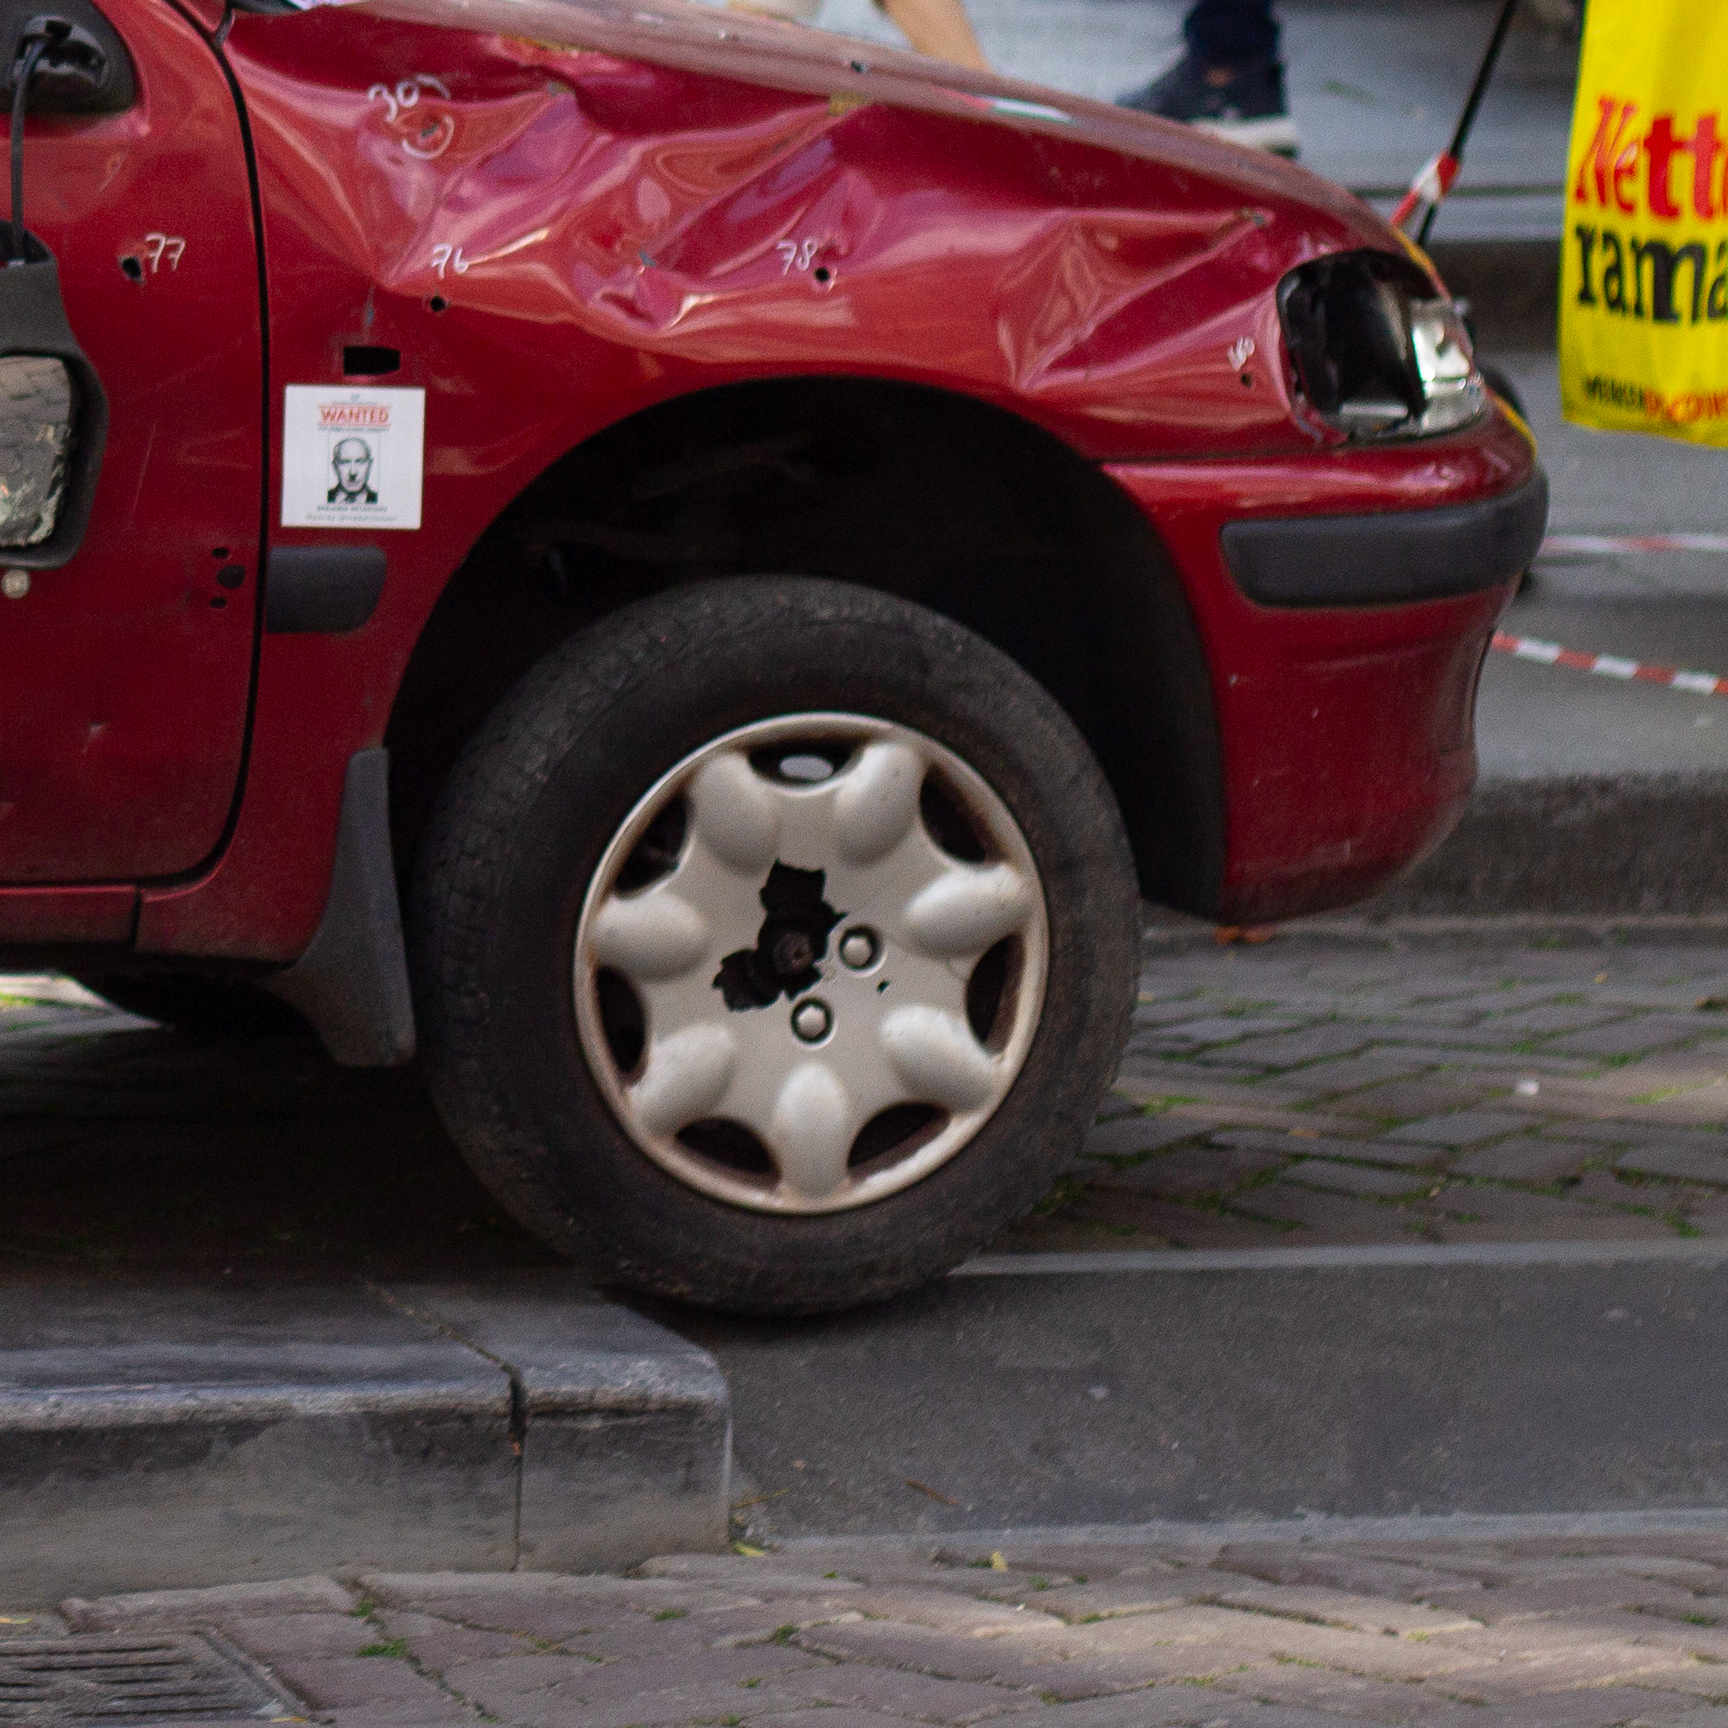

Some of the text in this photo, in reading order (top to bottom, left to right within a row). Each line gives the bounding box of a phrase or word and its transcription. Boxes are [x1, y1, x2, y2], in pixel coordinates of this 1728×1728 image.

[1575, 94, 1728, 221] Nett
[144, 231, 187, 274] 77
[431, 242, 471, 280] 76
[775, 236, 818, 276] 78
[320, 408, 390, 424] WANTED
